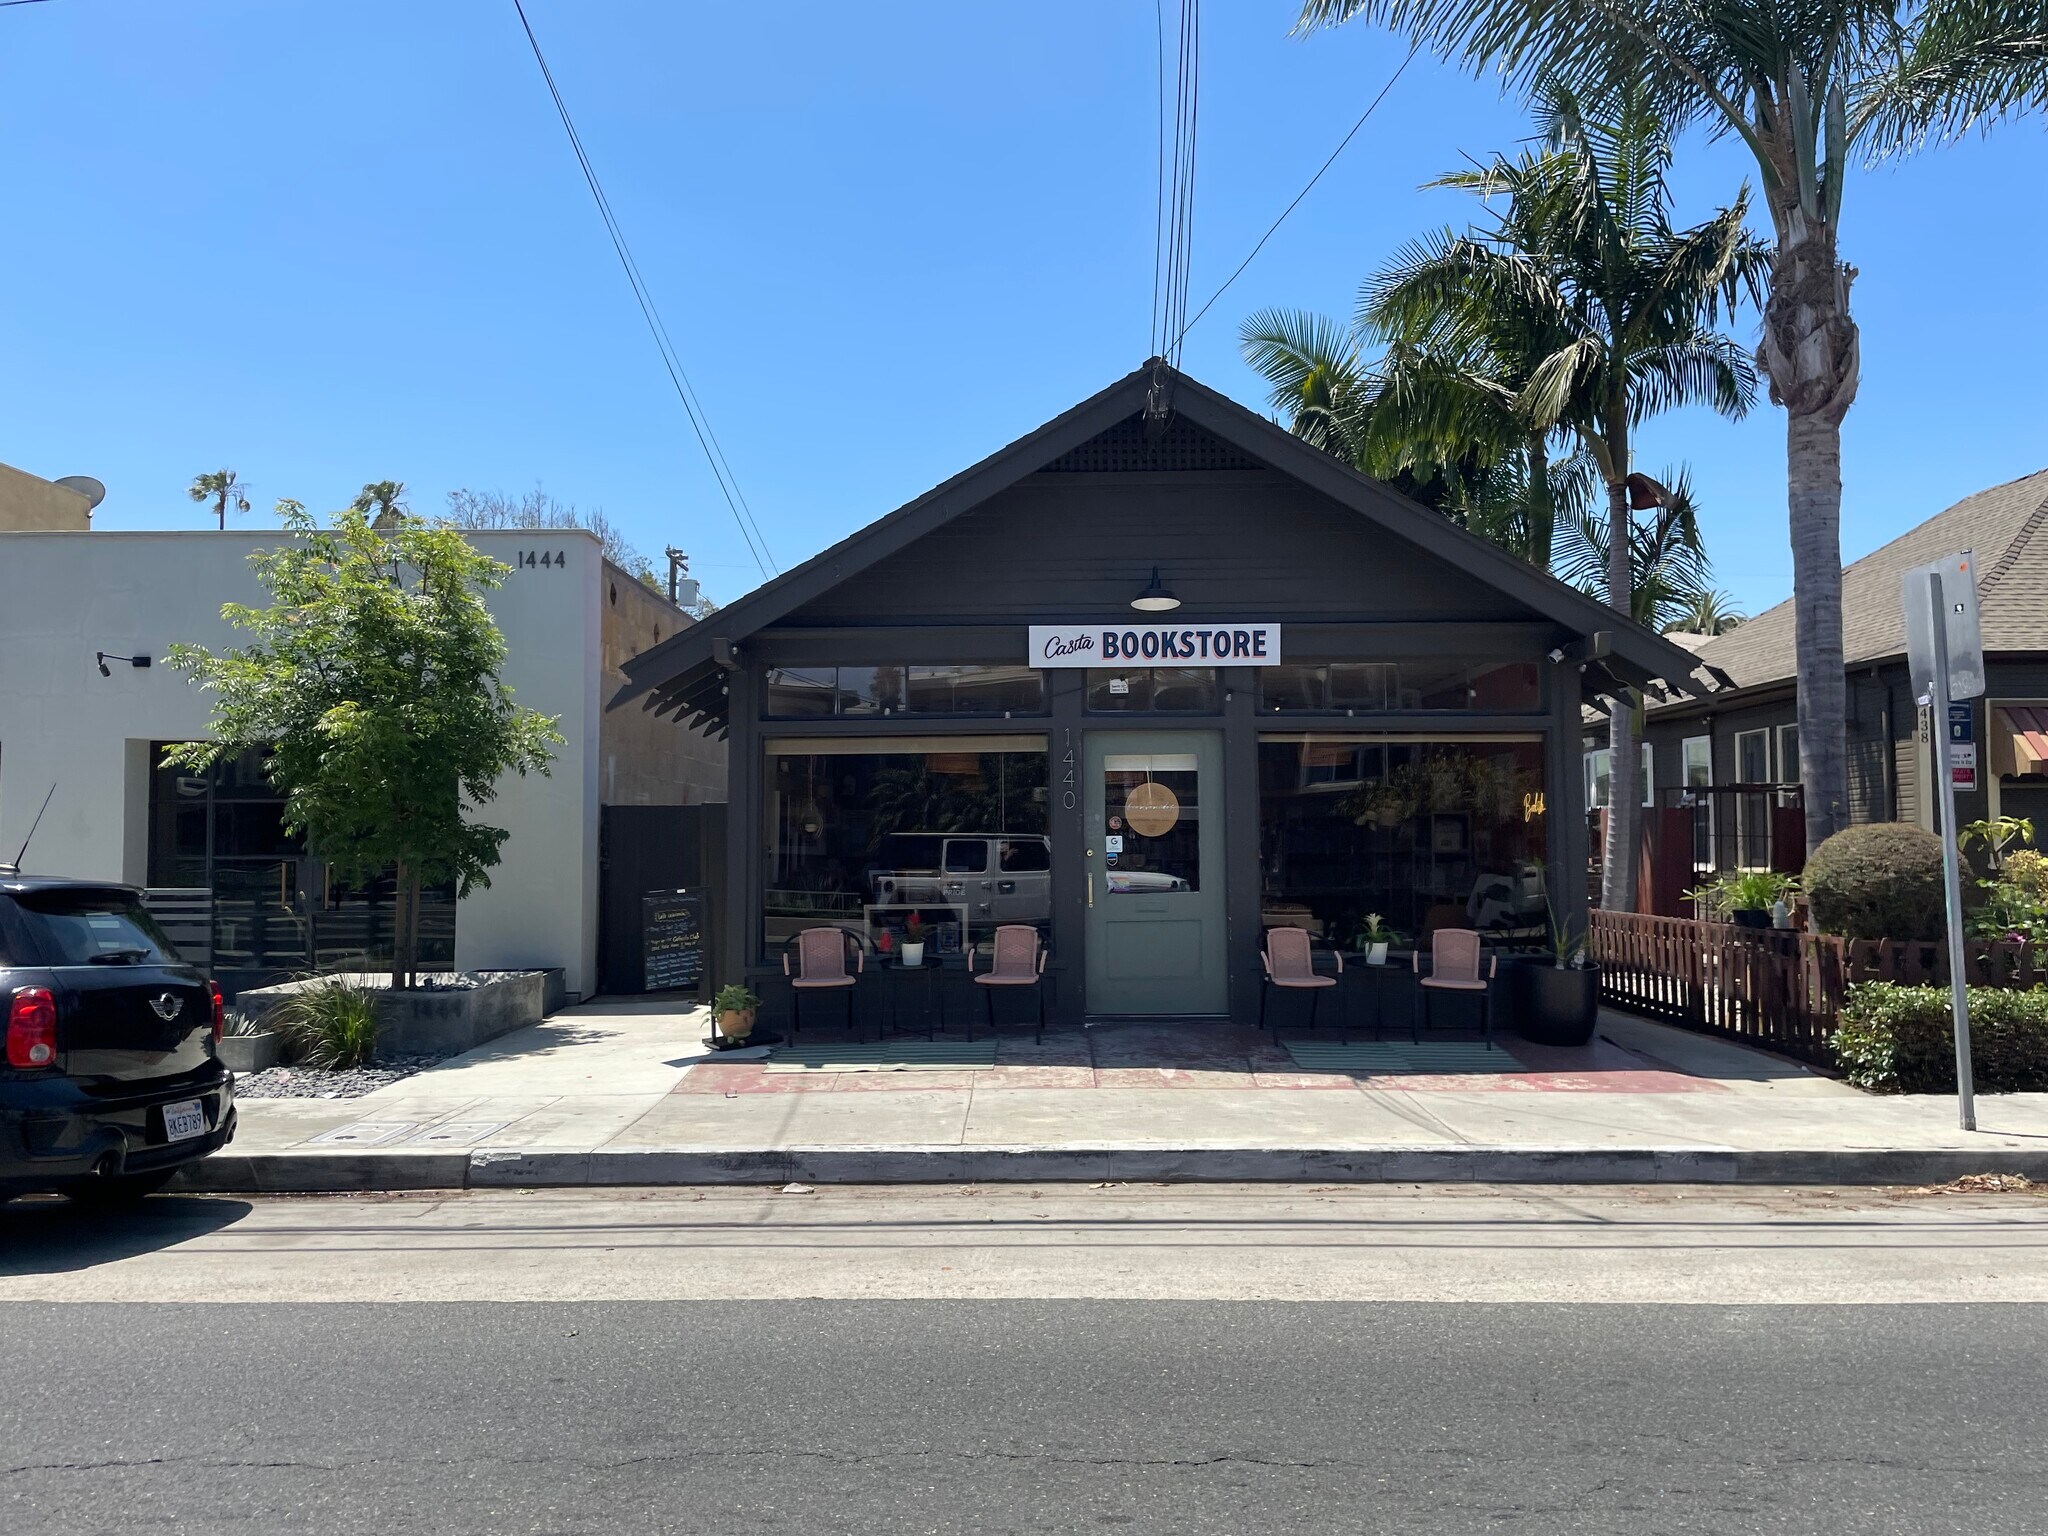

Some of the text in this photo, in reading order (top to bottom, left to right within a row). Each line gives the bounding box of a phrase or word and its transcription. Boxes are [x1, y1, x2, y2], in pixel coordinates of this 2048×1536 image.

[519, 551, 565, 568] 1444
[1044, 630, 1267, 660] Casita BOOKSTORE
[1063, 728, 1075, 809] 1440
[168, 1113, 201, 1135] 8KEB789
